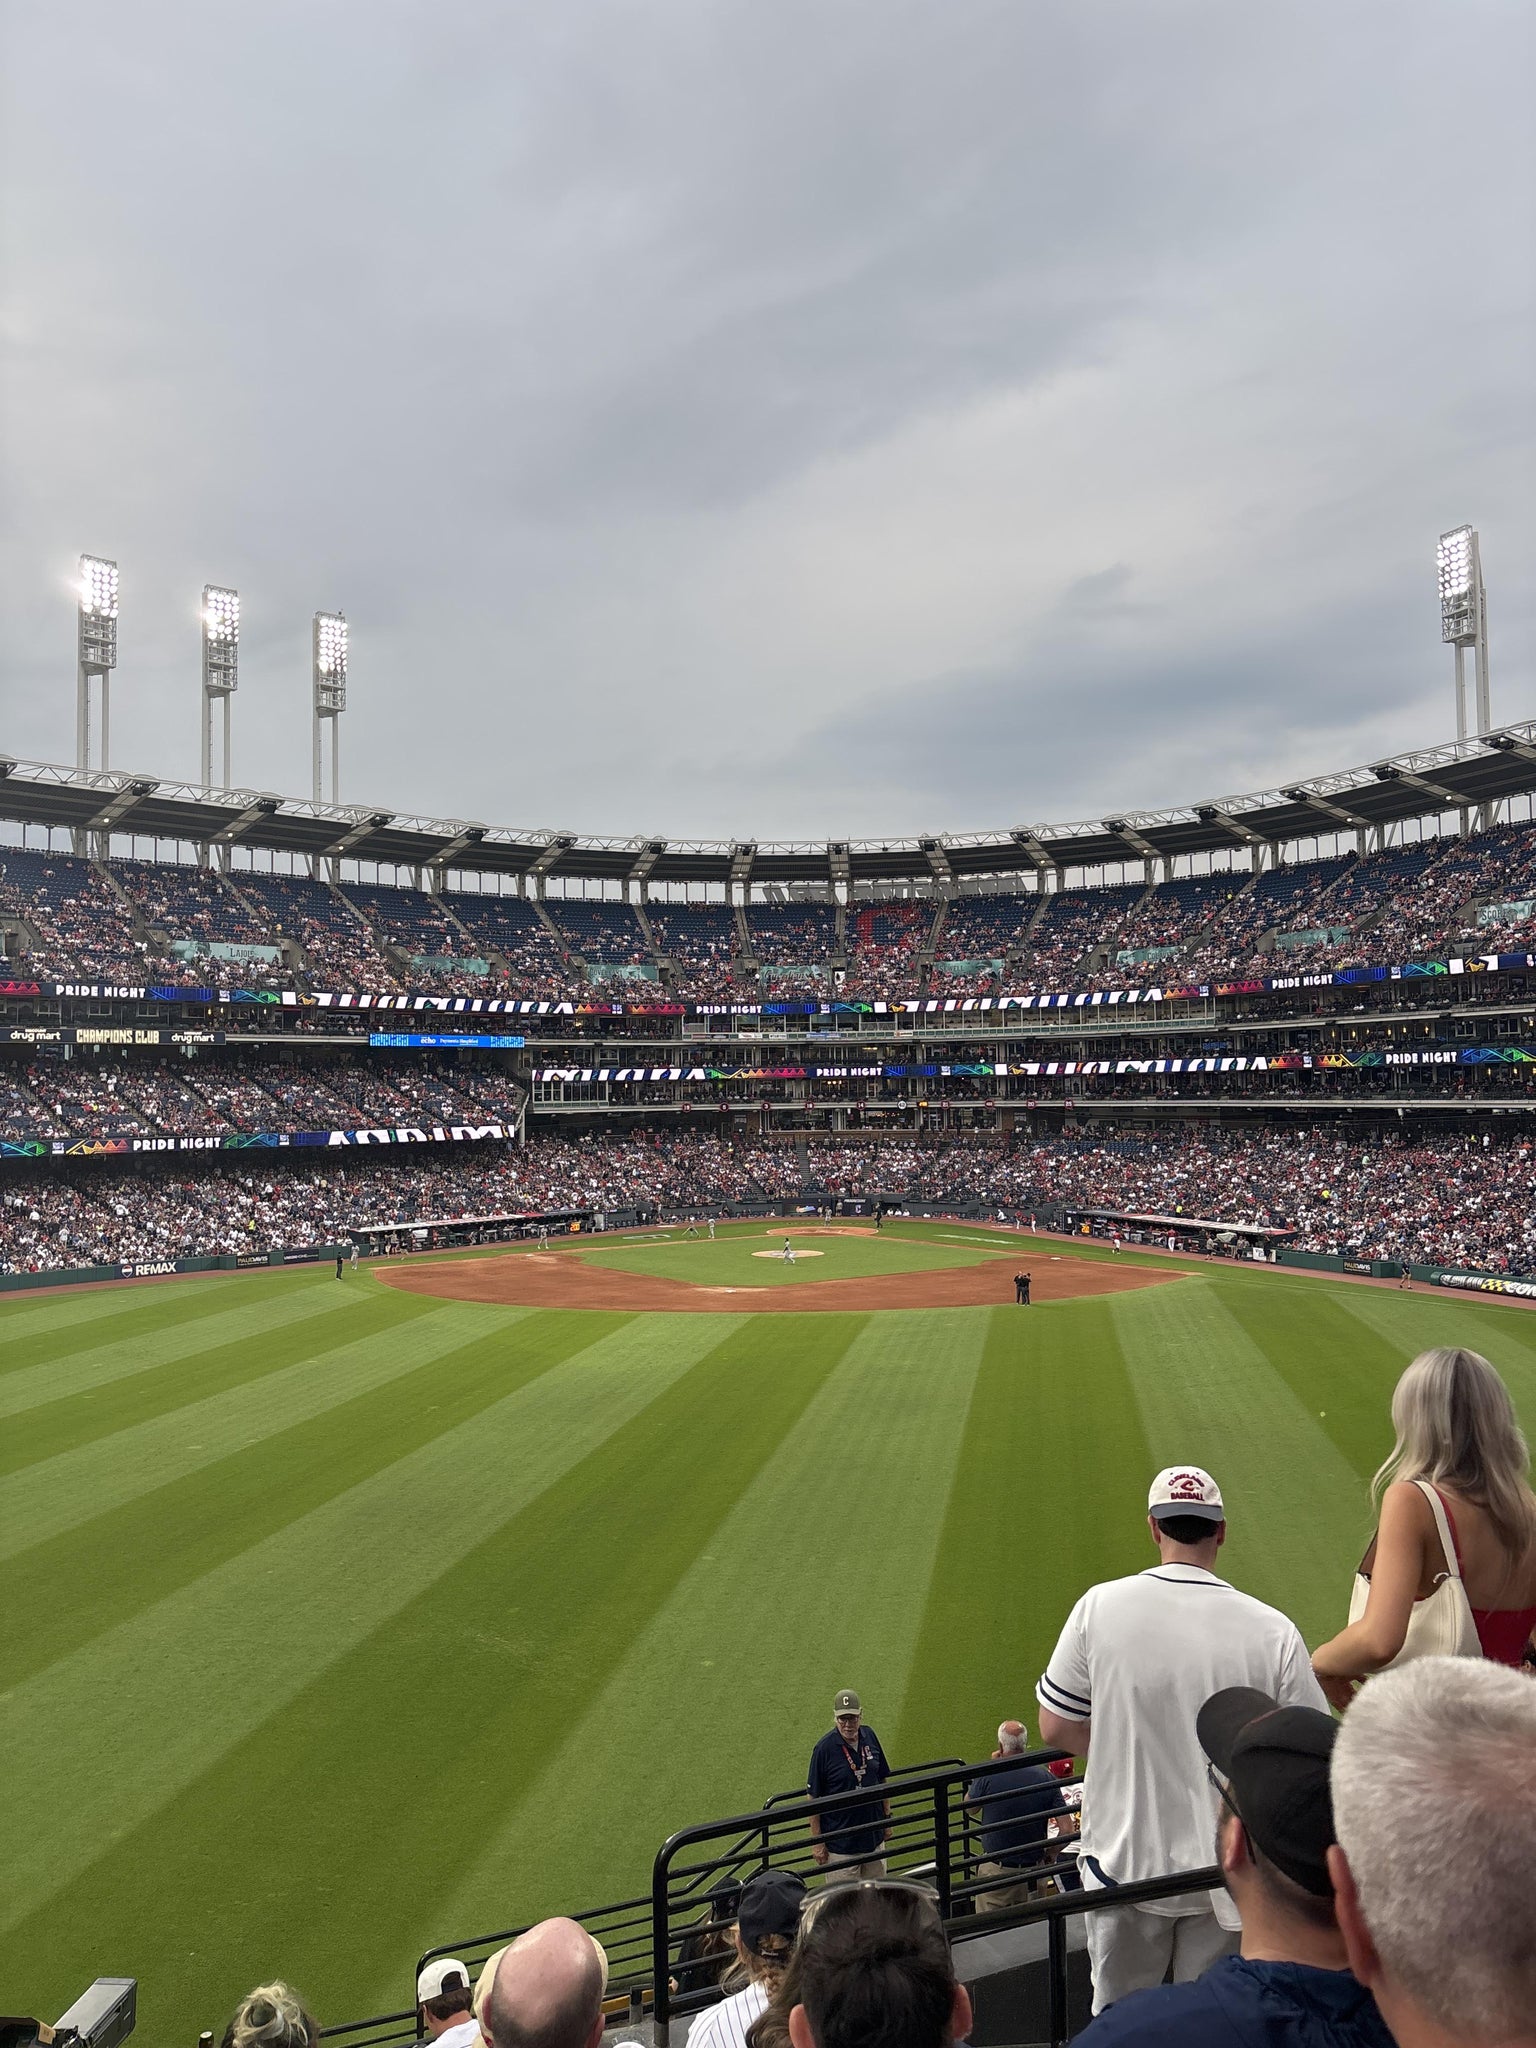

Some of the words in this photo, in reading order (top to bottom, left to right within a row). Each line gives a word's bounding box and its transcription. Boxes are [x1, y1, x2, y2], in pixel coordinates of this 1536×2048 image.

[1272, 977, 1300, 989] PRIDE
[1303, 974, 1333, 986] NIGHT
[56, 984, 99, 997] PRIDE
[104, 986, 146, 998] NIGHT
[696, 1005, 727, 1014] PRIDE
[731, 1005, 762, 1014] NIGHT
[10, 1031, 35, 1042] drug
[36, 1031, 61, 1040] mart
[76, 1029, 133, 1044] CHAMPIONS
[135, 1030, 160, 1044] CLUB
[171, 1033, 192, 1044] drug
[193, 1033, 215, 1042] mart
[1385, 1053, 1418, 1065] PRIDE
[1422, 1051, 1457, 1063] NIGHT
[816, 1068, 847, 1077] PRIDE
[850, 1067, 882, 1076] NIGHT
[133, 1139, 175, 1151] PRIDE
[180, 1137, 221, 1149] NIGHT
[135, 1261, 177, 1276] REMAX
[1168, 1474, 1205, 1487] CLEVELAND
[1180, 1480, 1194, 1491] C
[1170, 1492, 1205, 1502] BASEBALL
[842, 1696, 849, 1706] C
